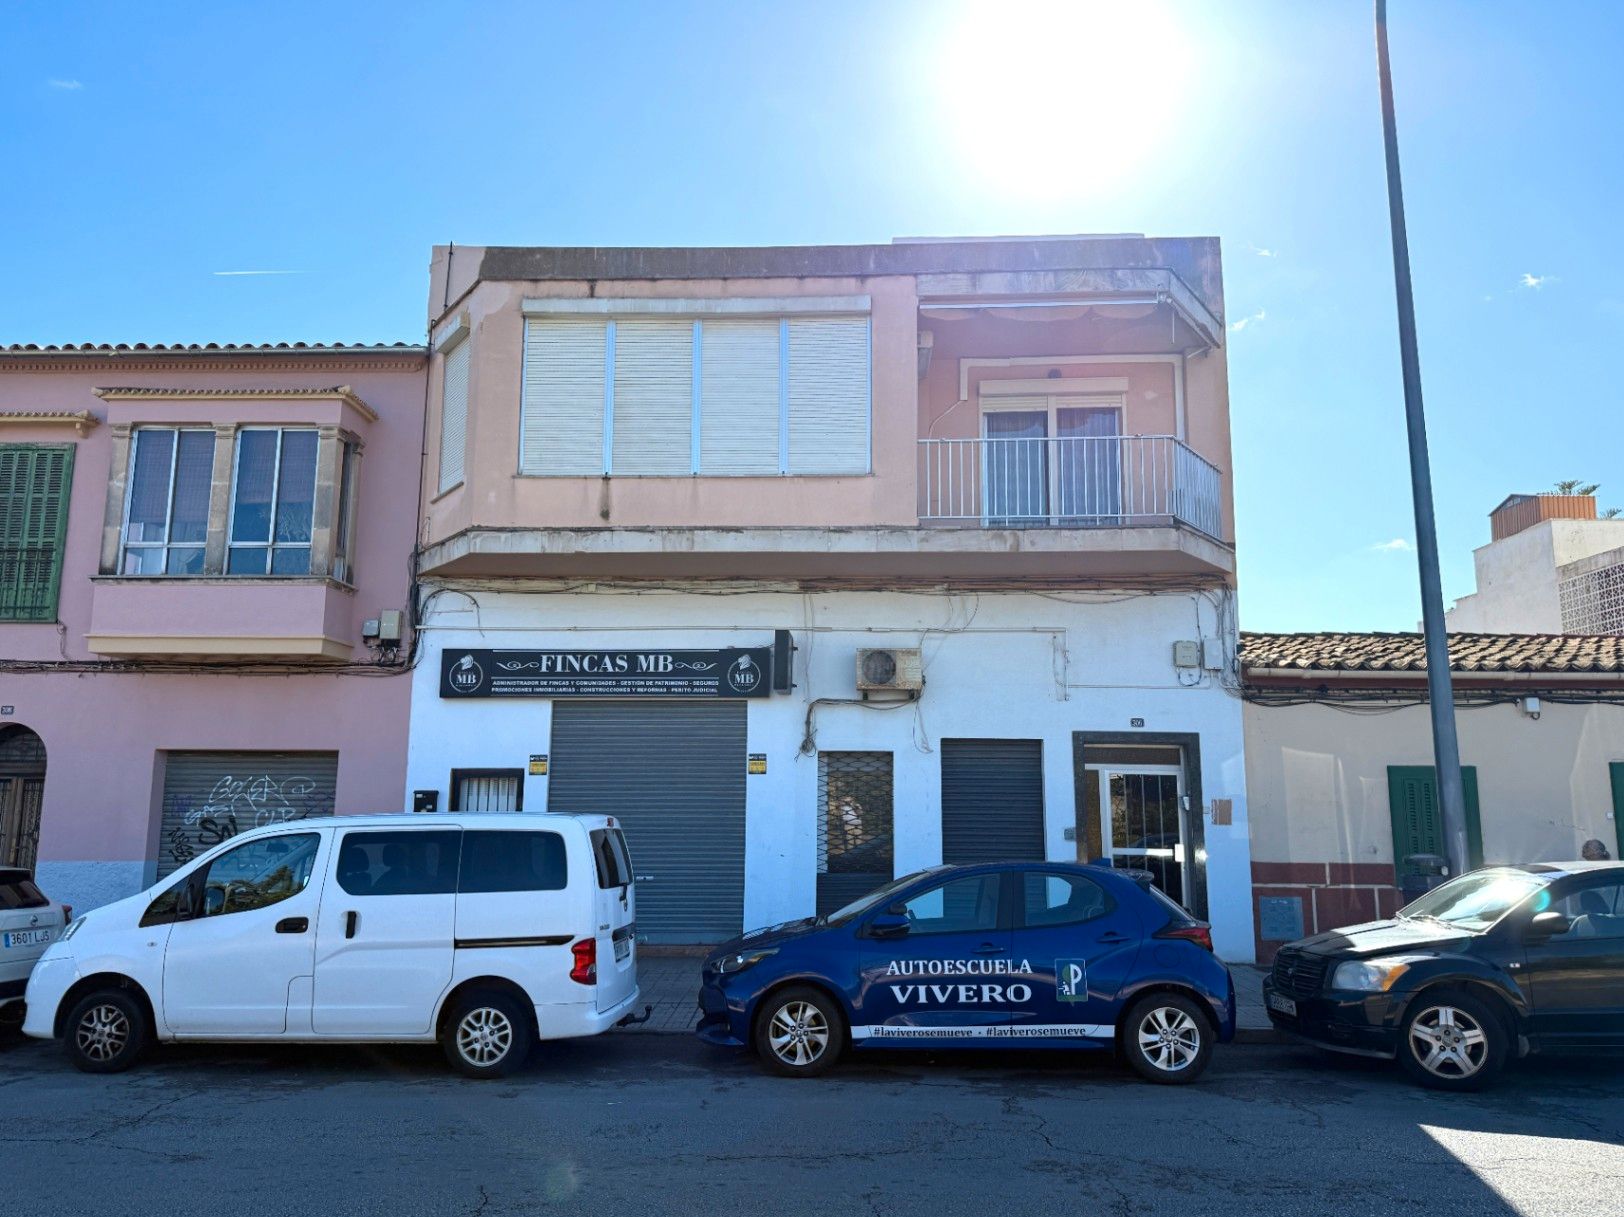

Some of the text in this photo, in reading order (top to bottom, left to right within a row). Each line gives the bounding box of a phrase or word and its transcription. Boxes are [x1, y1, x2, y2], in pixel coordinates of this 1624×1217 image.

[540, 654, 674, 672] FINCAS MB
[456, 674, 477, 684] MB
[734, 673, 754, 684] MB
[11, 932, 32, 944] 3601
[886, 958, 1032, 976] AUTOESCUELA
[890, 984, 1032, 1004] VIVERO
[874, 1026, 1086, 1037] #laviverosemueve #laviverosemueve
